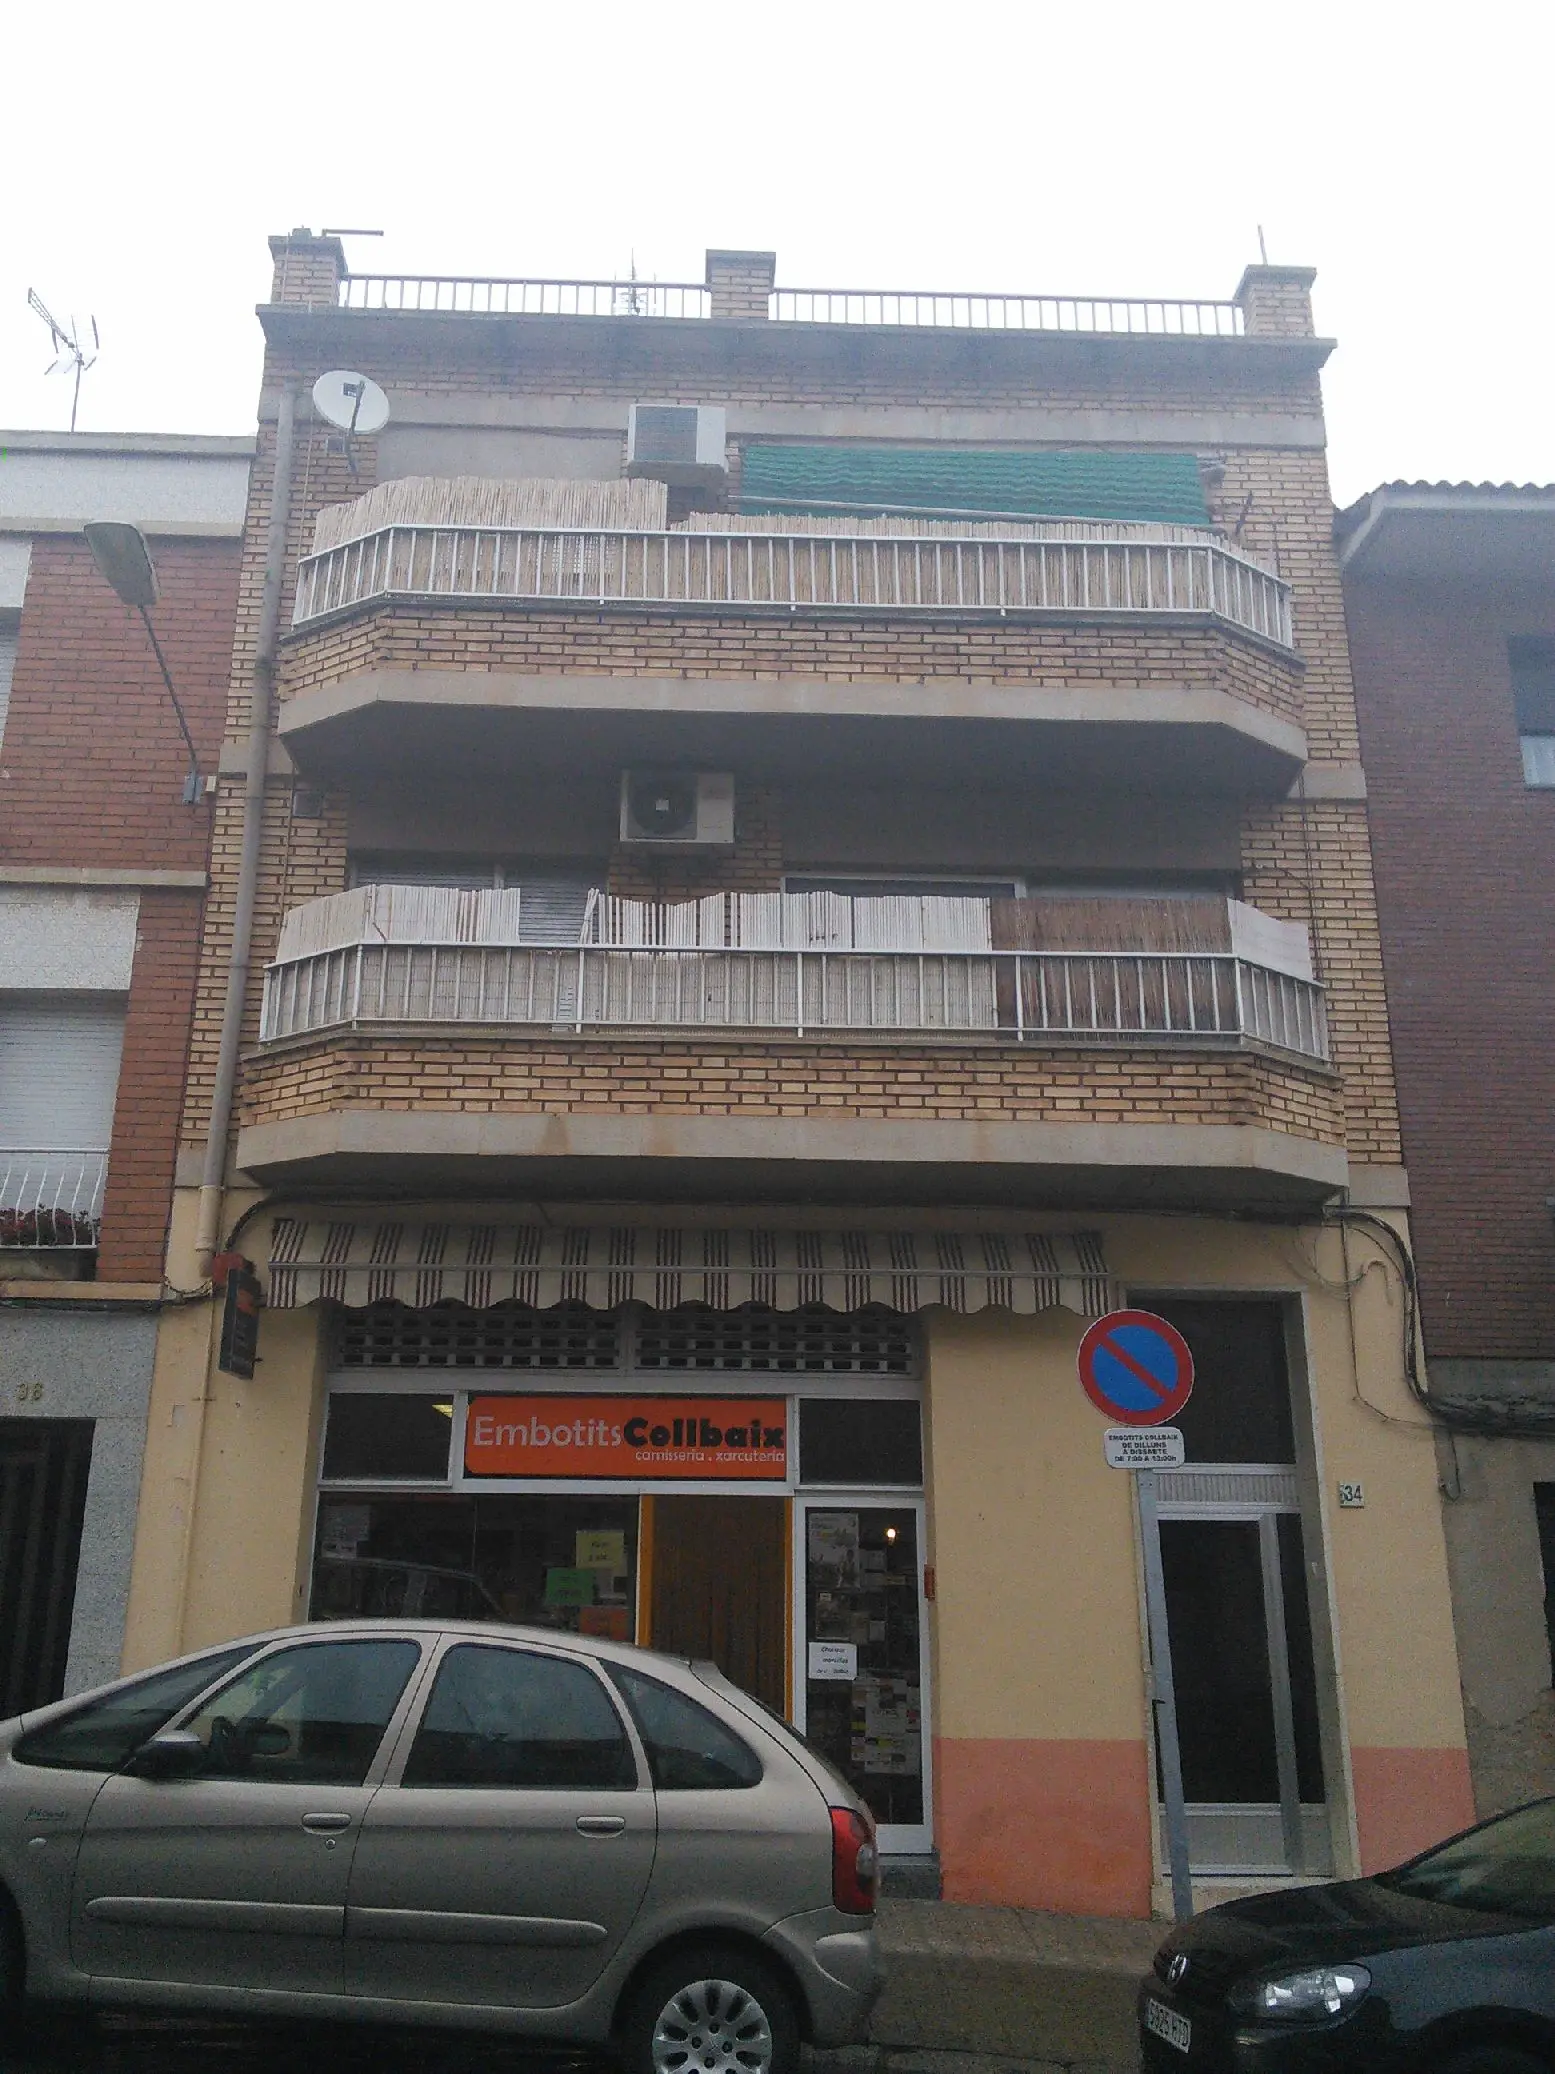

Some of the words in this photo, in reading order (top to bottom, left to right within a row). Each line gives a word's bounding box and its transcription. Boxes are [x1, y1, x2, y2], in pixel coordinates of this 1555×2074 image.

[474, 1416, 621, 1447] Embotits
[623, 1416, 785, 1448] Collbaix
[1344, 1485, 1362, 1501] 34
